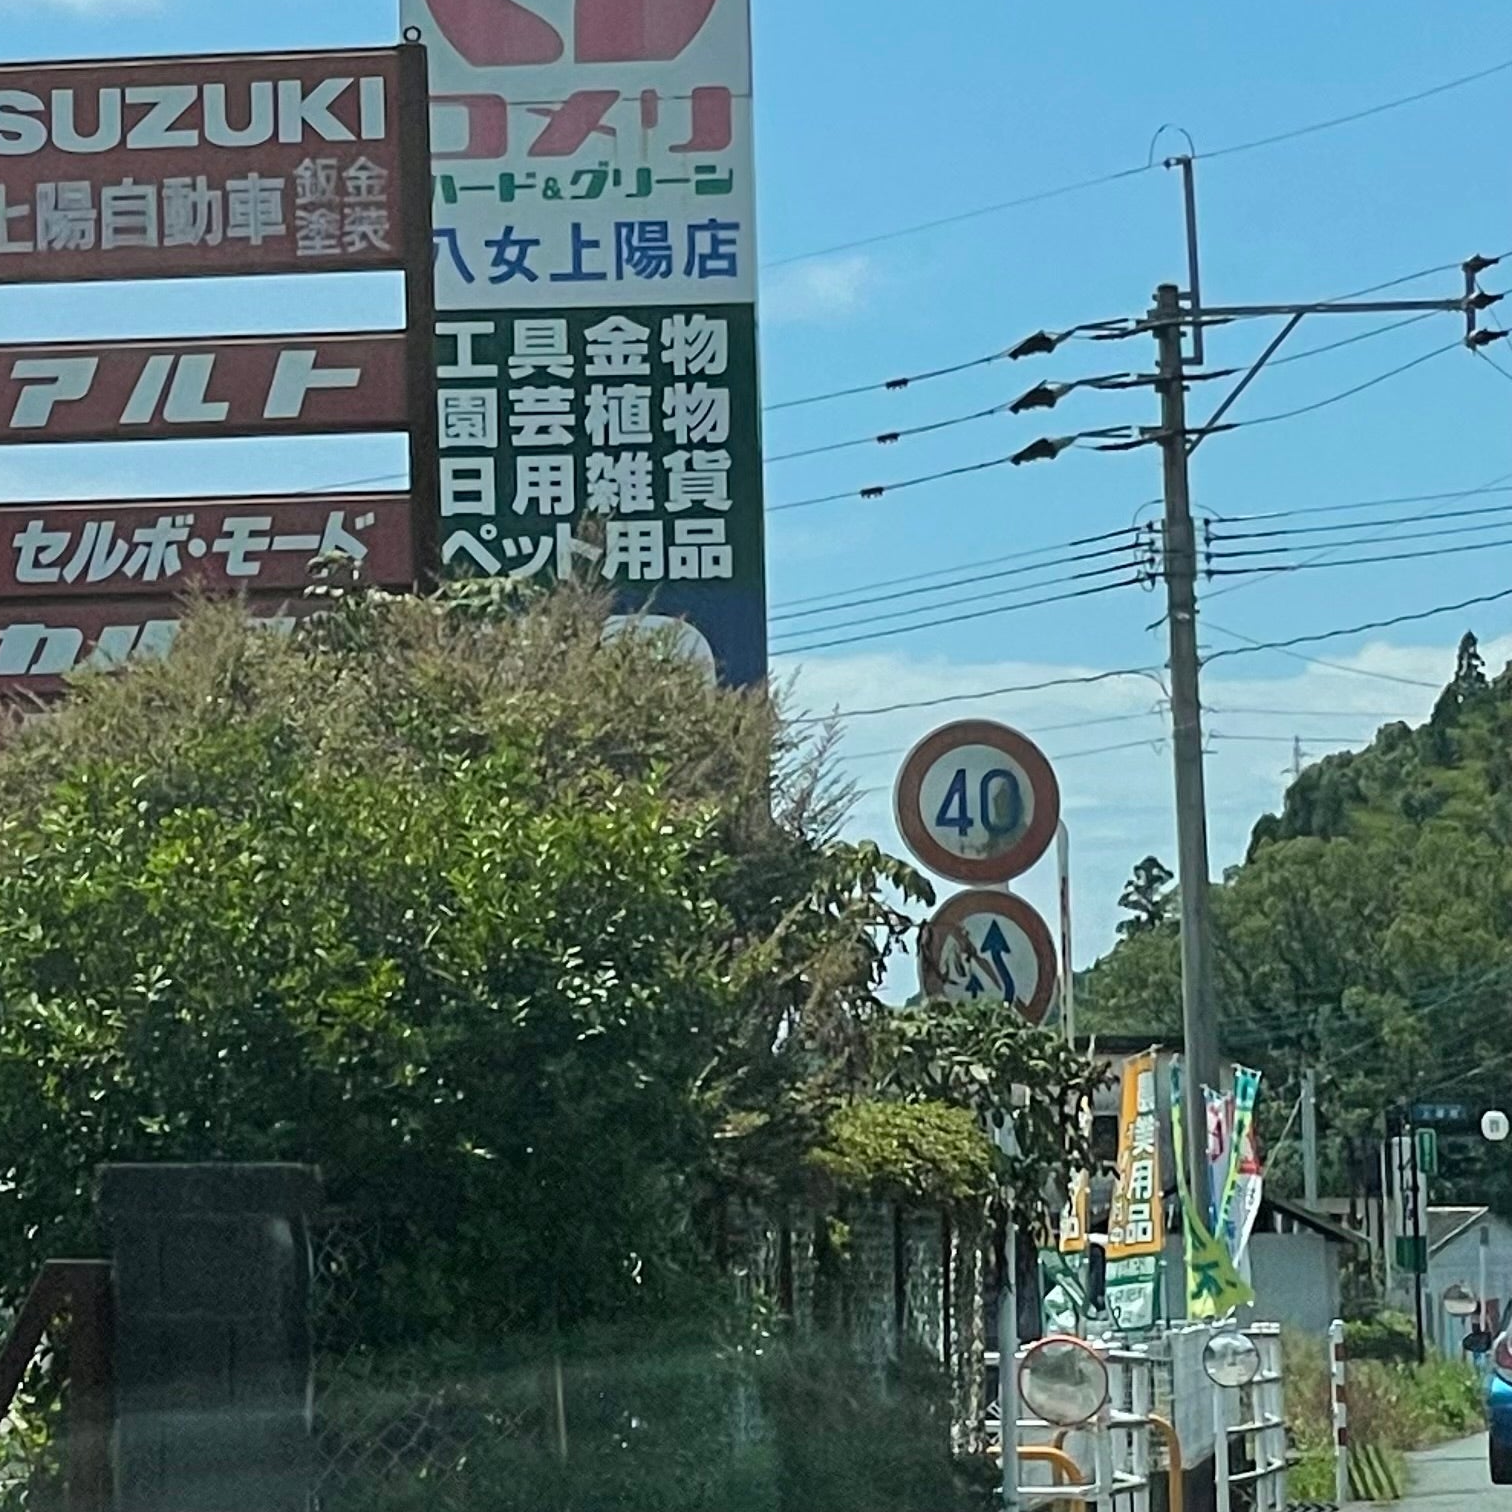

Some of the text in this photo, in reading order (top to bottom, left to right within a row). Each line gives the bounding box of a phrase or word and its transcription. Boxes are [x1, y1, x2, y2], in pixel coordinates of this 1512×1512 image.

[429, 86, 733, 159] コメリ
[293, 156, 389, 206] 鈑金
[295, 206, 392, 257] 塗装
[433, 218, 740, 285] 八女上陽店
[434, 314, 729, 380] 工具金物
[9, 349, 362, 429] アルト
[437, 382, 731, 449] 園芸植物
[439, 449, 733, 516] 日用雑貨
[442, 518, 733, 580] ペット用品
[935, 768, 1022, 837] 40
